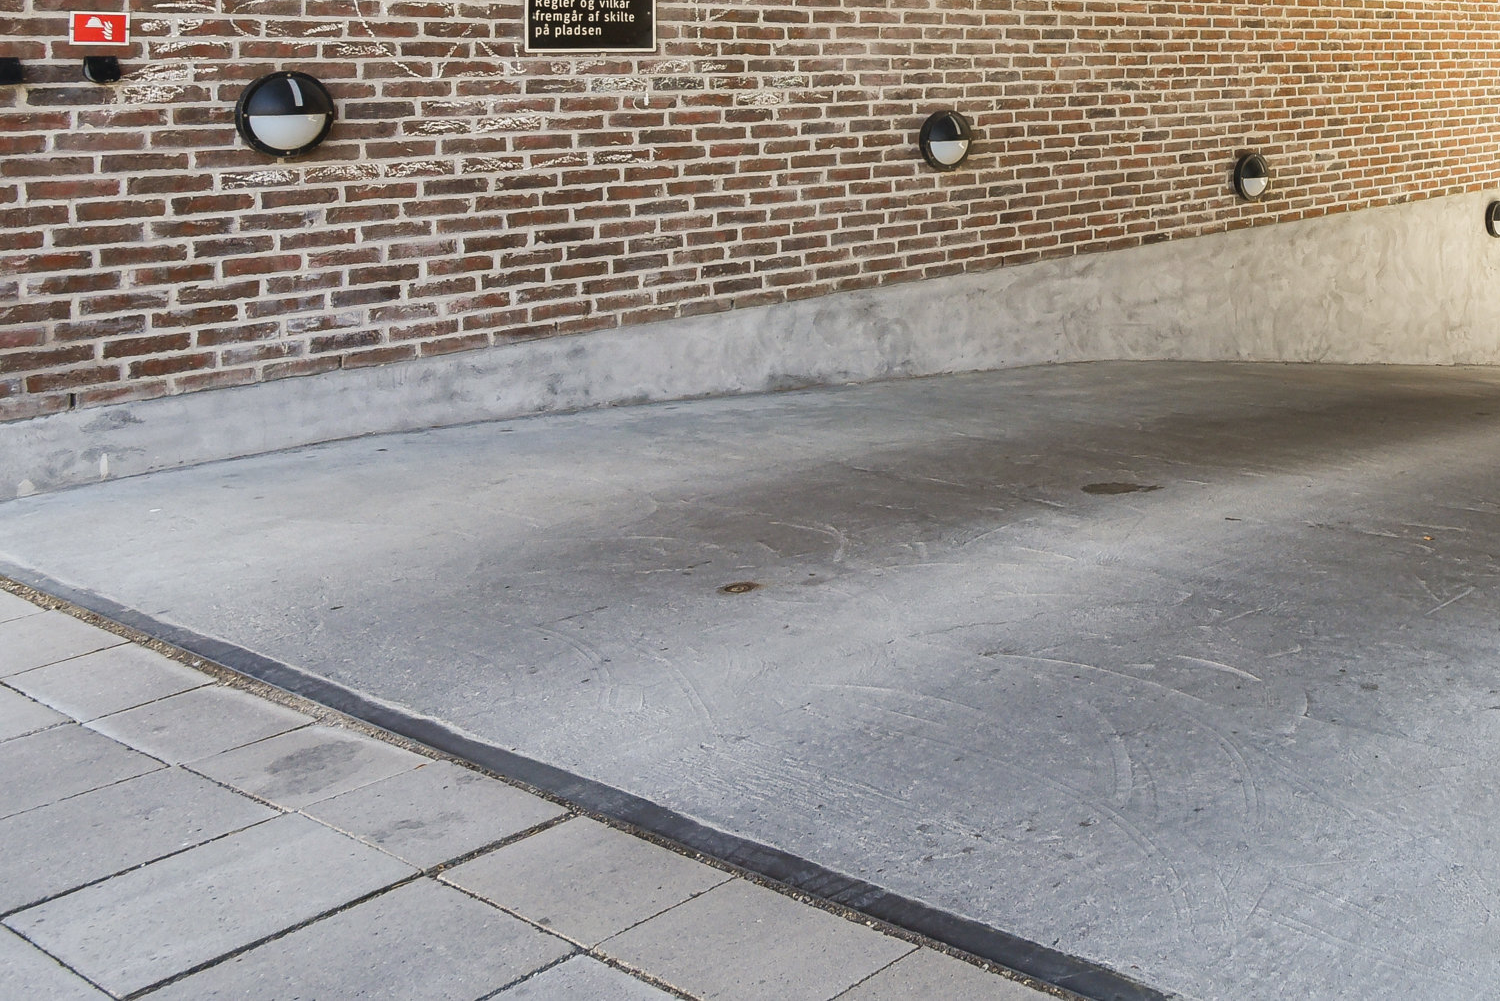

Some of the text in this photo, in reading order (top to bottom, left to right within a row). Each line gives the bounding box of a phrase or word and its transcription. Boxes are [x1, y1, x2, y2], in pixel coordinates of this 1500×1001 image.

[580, 0, 595, 11] og
[535, 10, 635, 24] fremgår af skilte
[535, 23, 602, 38] på pladsen
